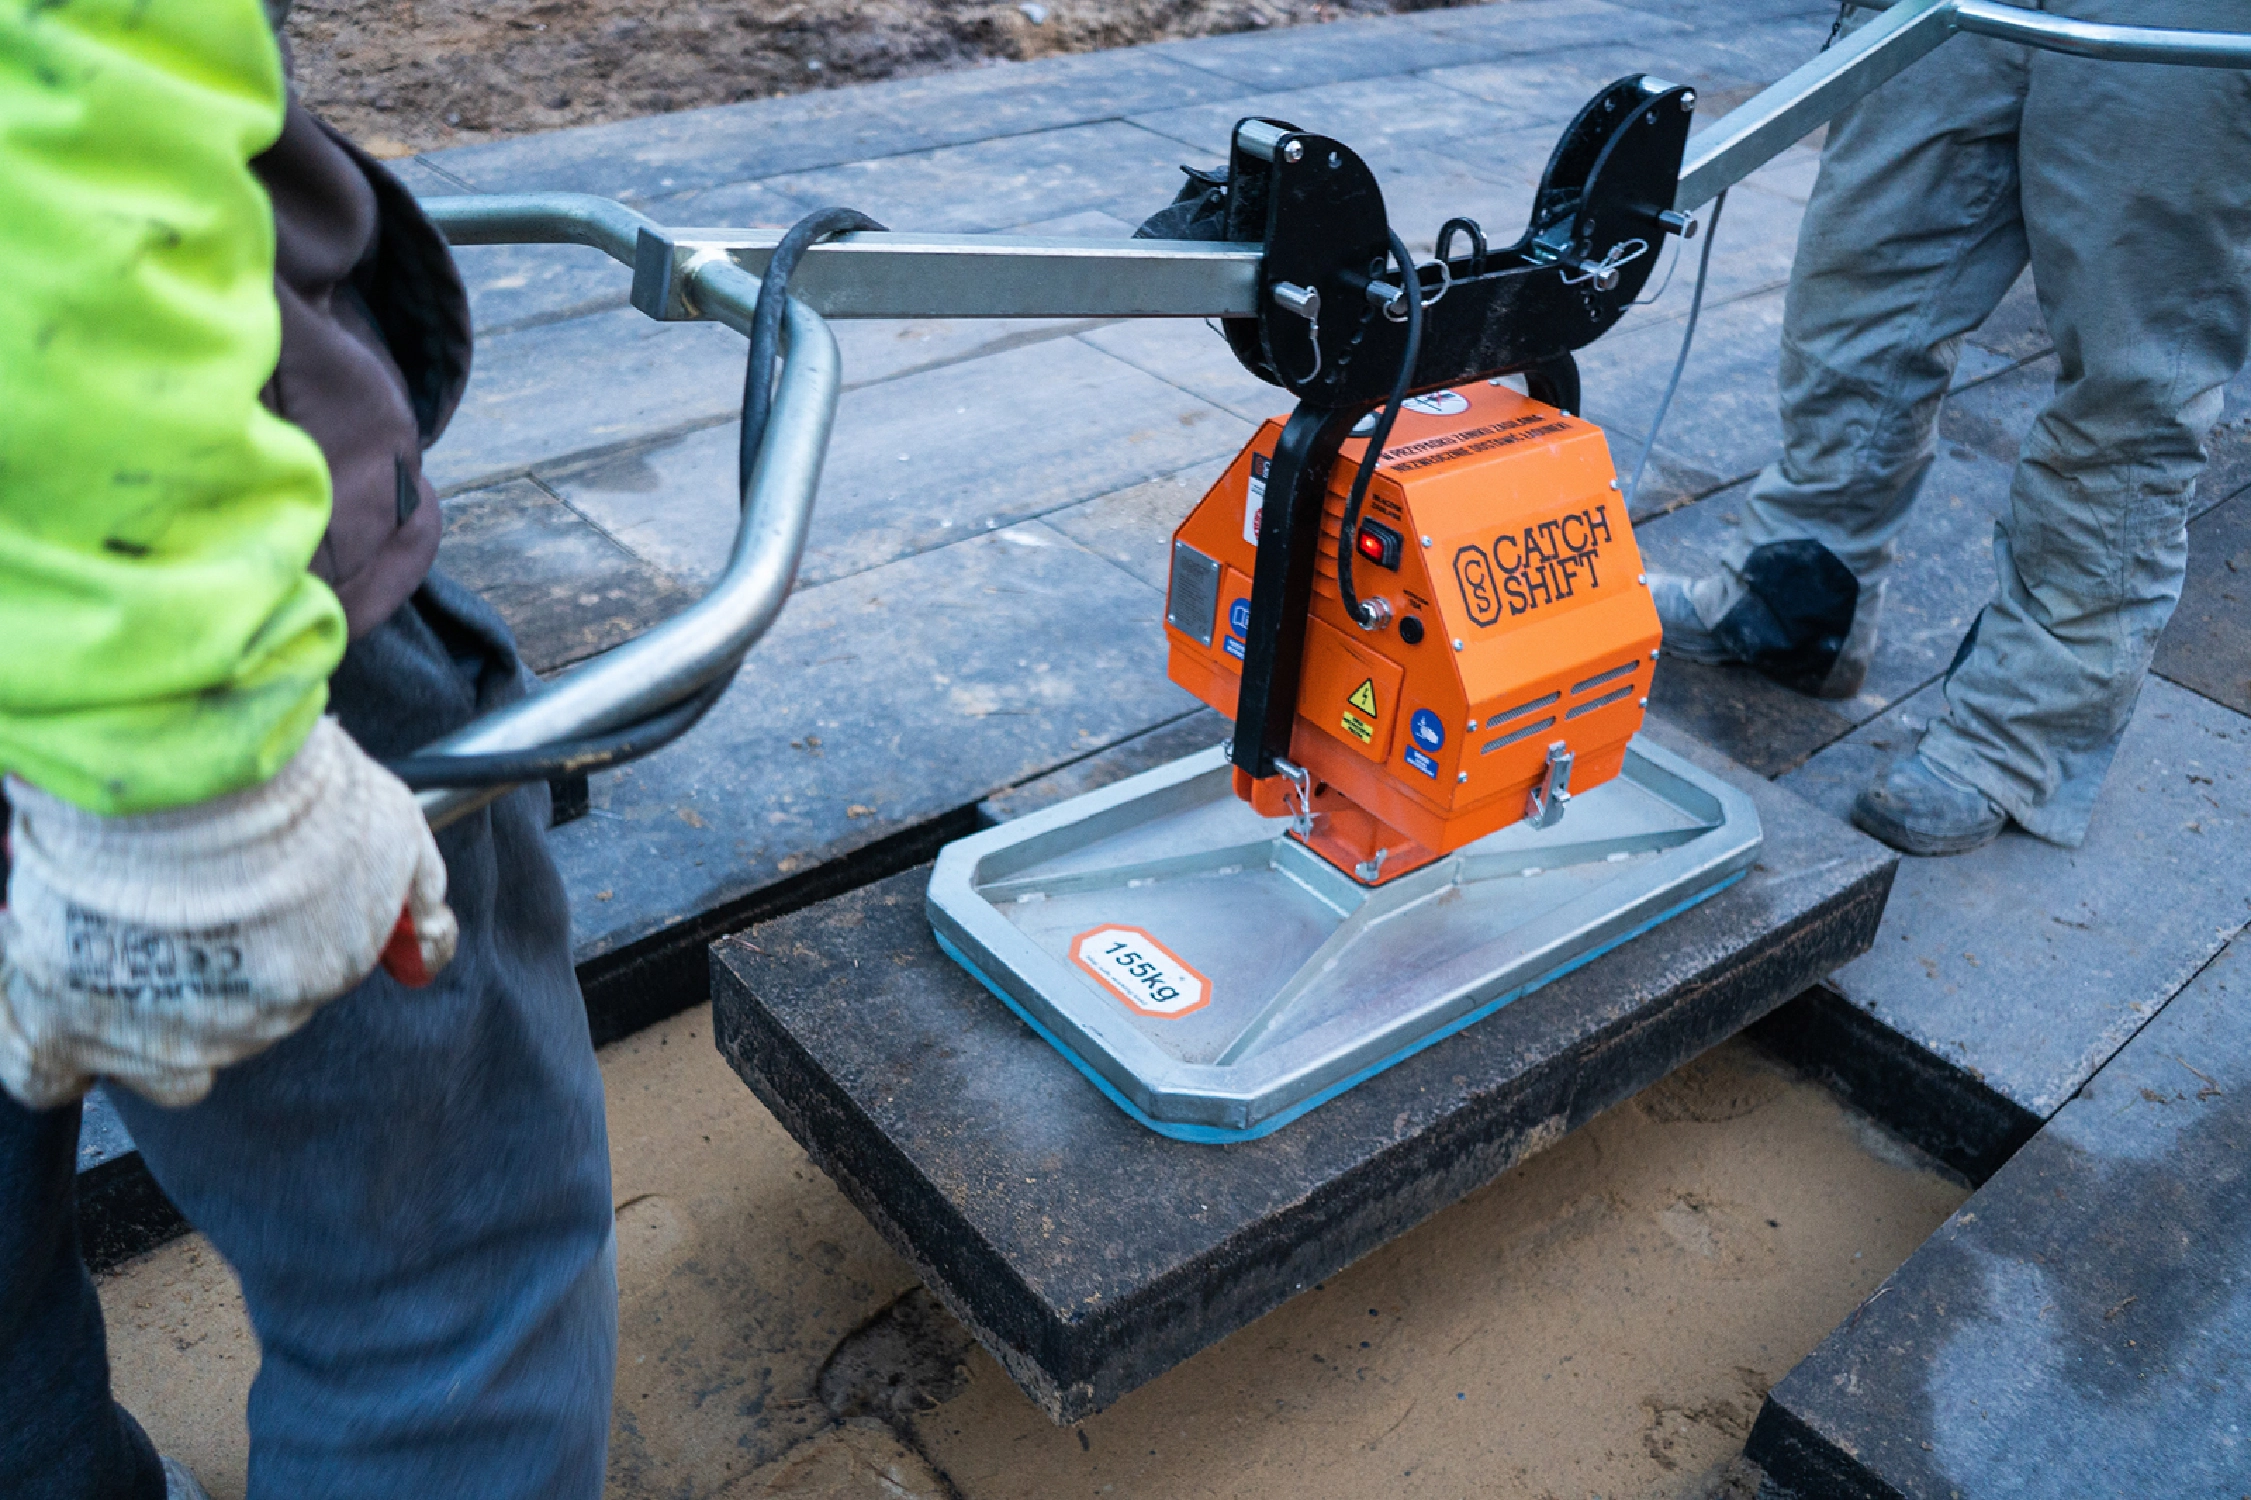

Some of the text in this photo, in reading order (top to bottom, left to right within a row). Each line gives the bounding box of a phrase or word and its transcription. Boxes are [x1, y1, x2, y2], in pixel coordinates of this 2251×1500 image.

[1493, 504, 1612, 574] CATCH
[1503, 549, 1599, 616] SHIFT
[1104, 941, 1180, 1003] 155kg
